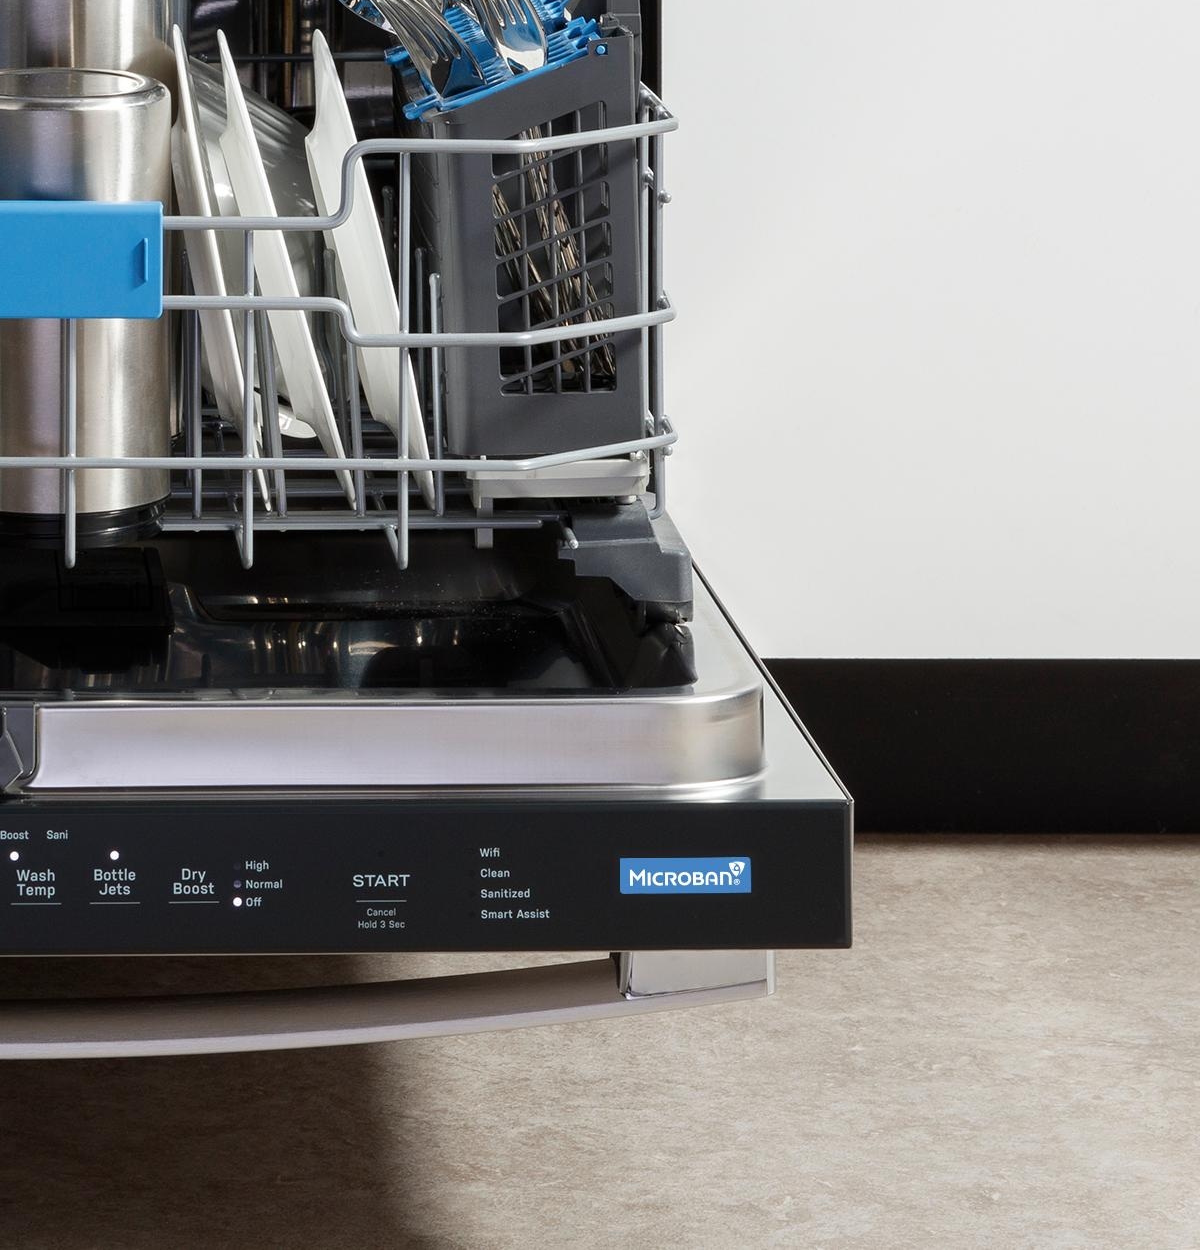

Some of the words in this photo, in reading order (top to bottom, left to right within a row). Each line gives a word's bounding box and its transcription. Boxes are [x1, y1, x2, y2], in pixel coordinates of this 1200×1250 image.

[0, 830, 30, 840] Boost
[46, 829, 69, 840] Sani
[479, 847, 500, 858] Wifi
[245, 859, 270, 873] High
[16, 868, 56, 882] Wash
[93, 867, 136, 882] Bottle
[181, 867, 207, 883] Dry
[480, 867, 511, 879] Clean
[245, 878, 283, 890] Normal
[352, 874, 411, 888] START
[16, 883, 56, 899] Temp
[98, 882, 131, 896] Jets
[173, 881, 215, 895] Boost
[480, 887, 531, 899] Sanitized
[245, 896, 262, 907] Off
[366, 907, 397, 917] Cancel
[480, 909, 513, 920] Smart
[516, 908, 550, 919] Assist
[357, 919, 378, 929] Hold
[379, 919, 386, 929] 3
[388, 919, 406, 929] Sec
